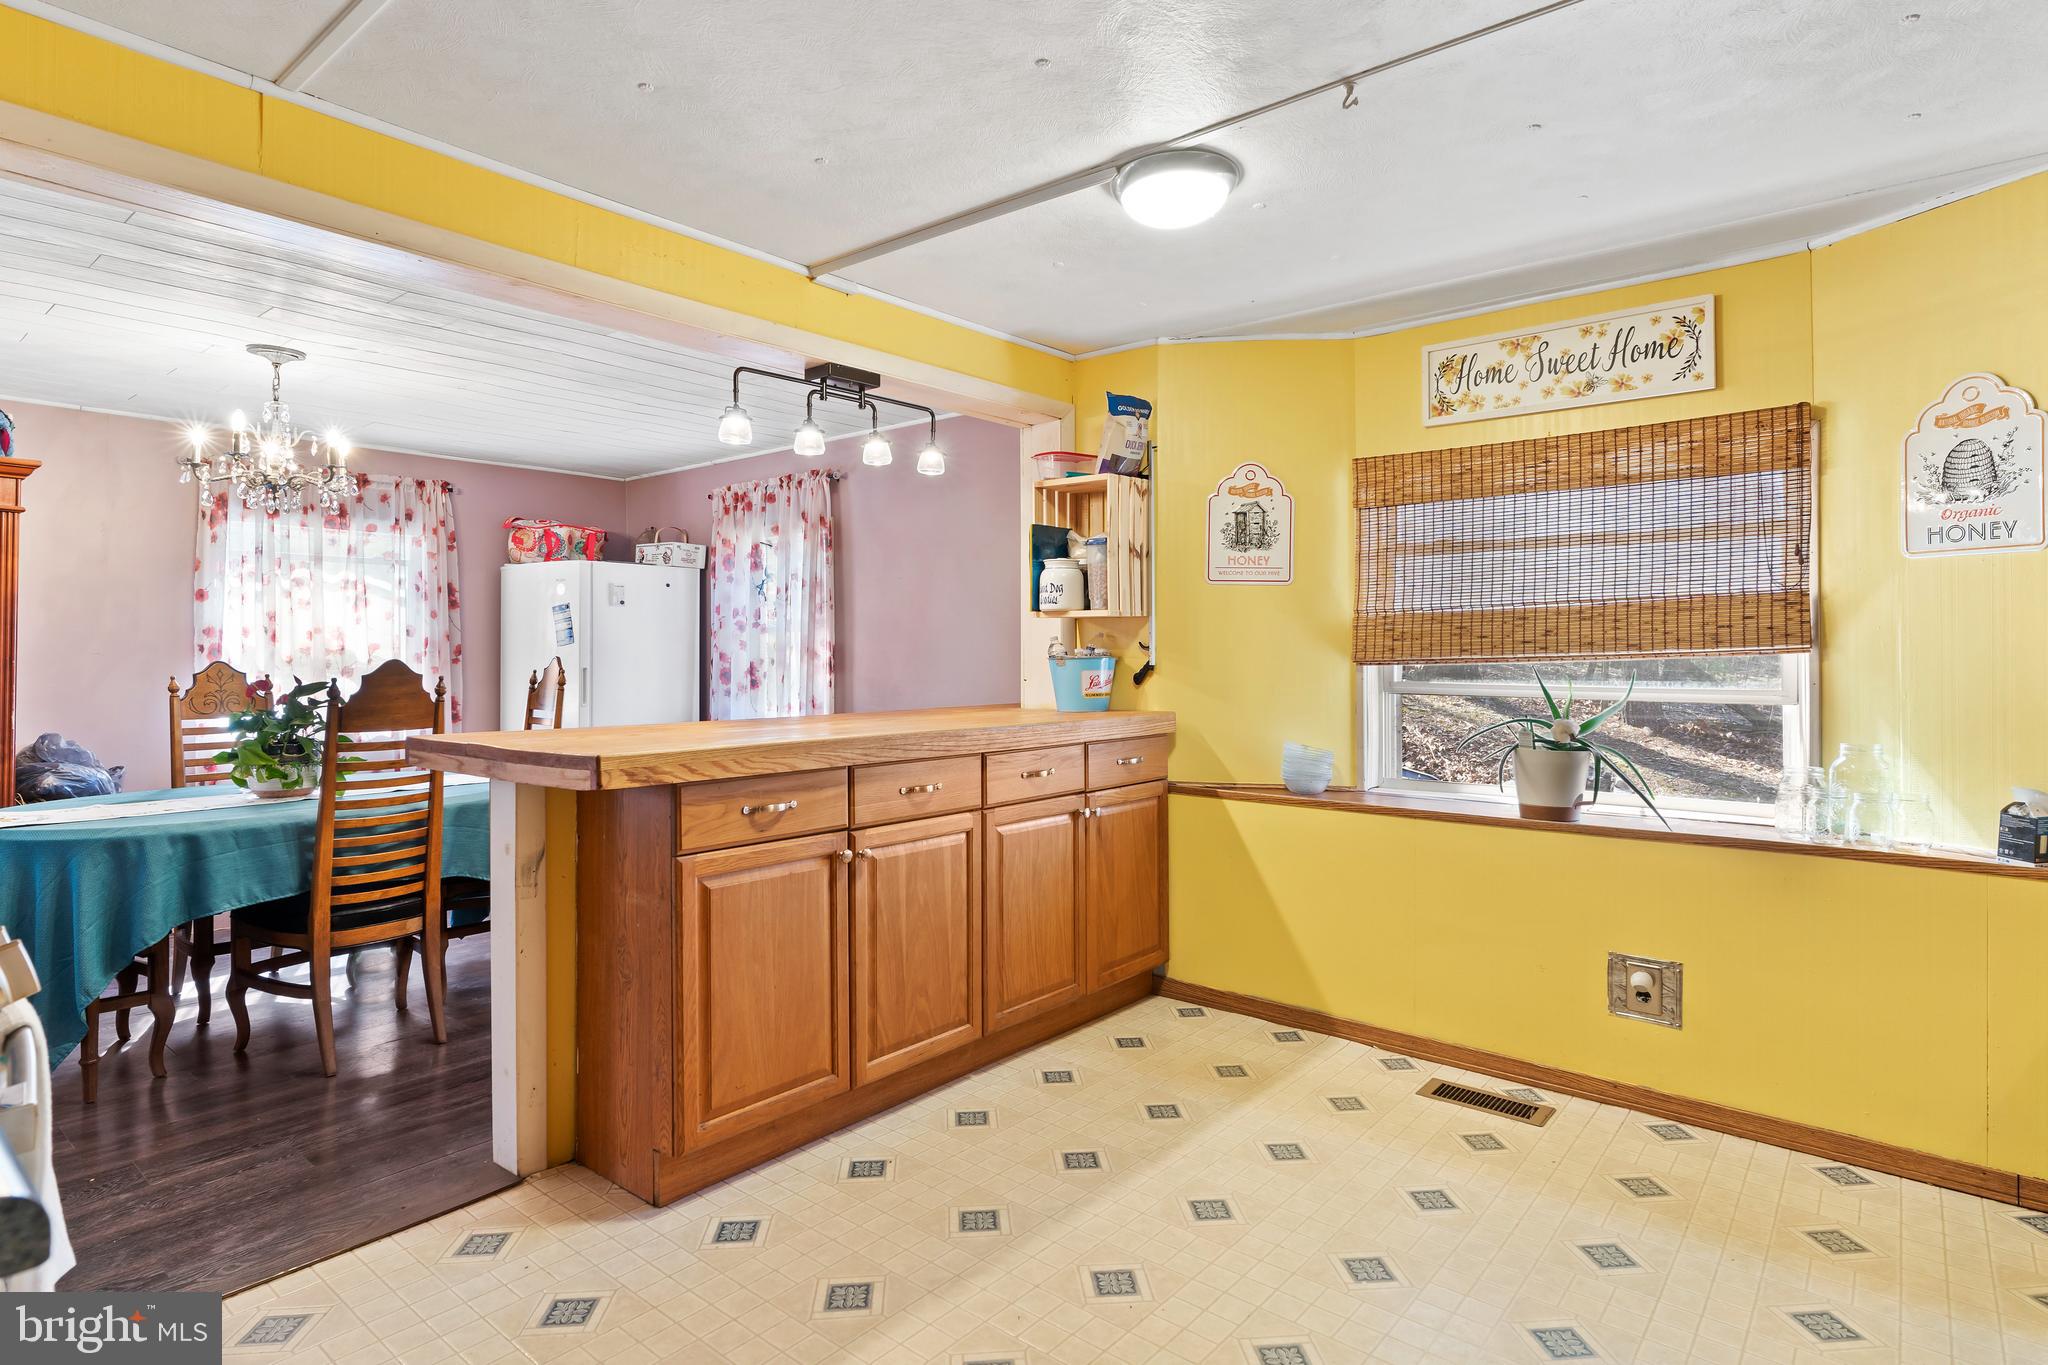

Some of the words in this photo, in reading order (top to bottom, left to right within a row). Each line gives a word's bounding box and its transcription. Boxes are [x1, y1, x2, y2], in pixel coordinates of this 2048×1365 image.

[1450, 352, 1518, 395] Home
[1525, 341, 1600, 383] Sweet
[1602, 325, 1685, 371] Home
[1941, 503, 2003, 522] Organic
[1927, 519, 2018, 545] HONEY
[1227, 555, 1270, 566] HONEY
[1050, 582, 1064, 597] Dog
